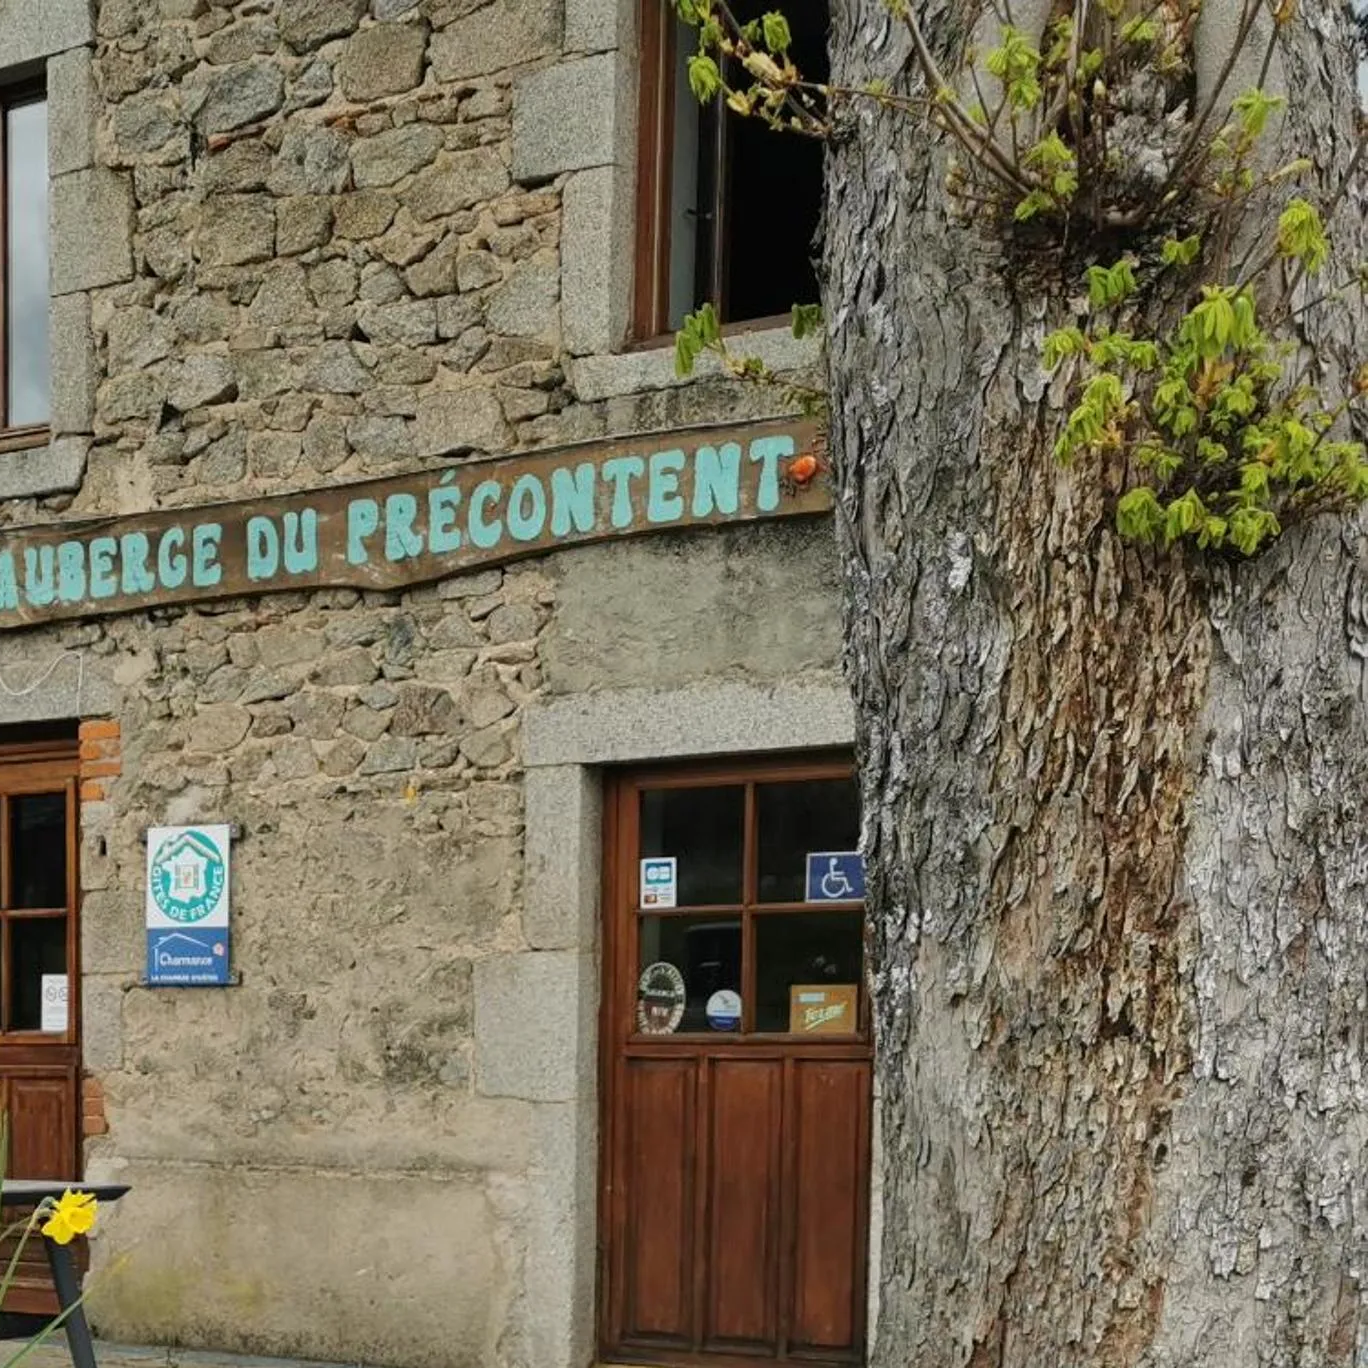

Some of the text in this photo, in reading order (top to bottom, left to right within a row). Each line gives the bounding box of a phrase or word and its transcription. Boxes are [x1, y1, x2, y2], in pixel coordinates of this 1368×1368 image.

[246, 507, 319, 580] DU
[346, 434, 795, 565] PRÉCONTENT
[170, 906, 187, 920] DE
[190, 866, 224, 920] FRANCE
